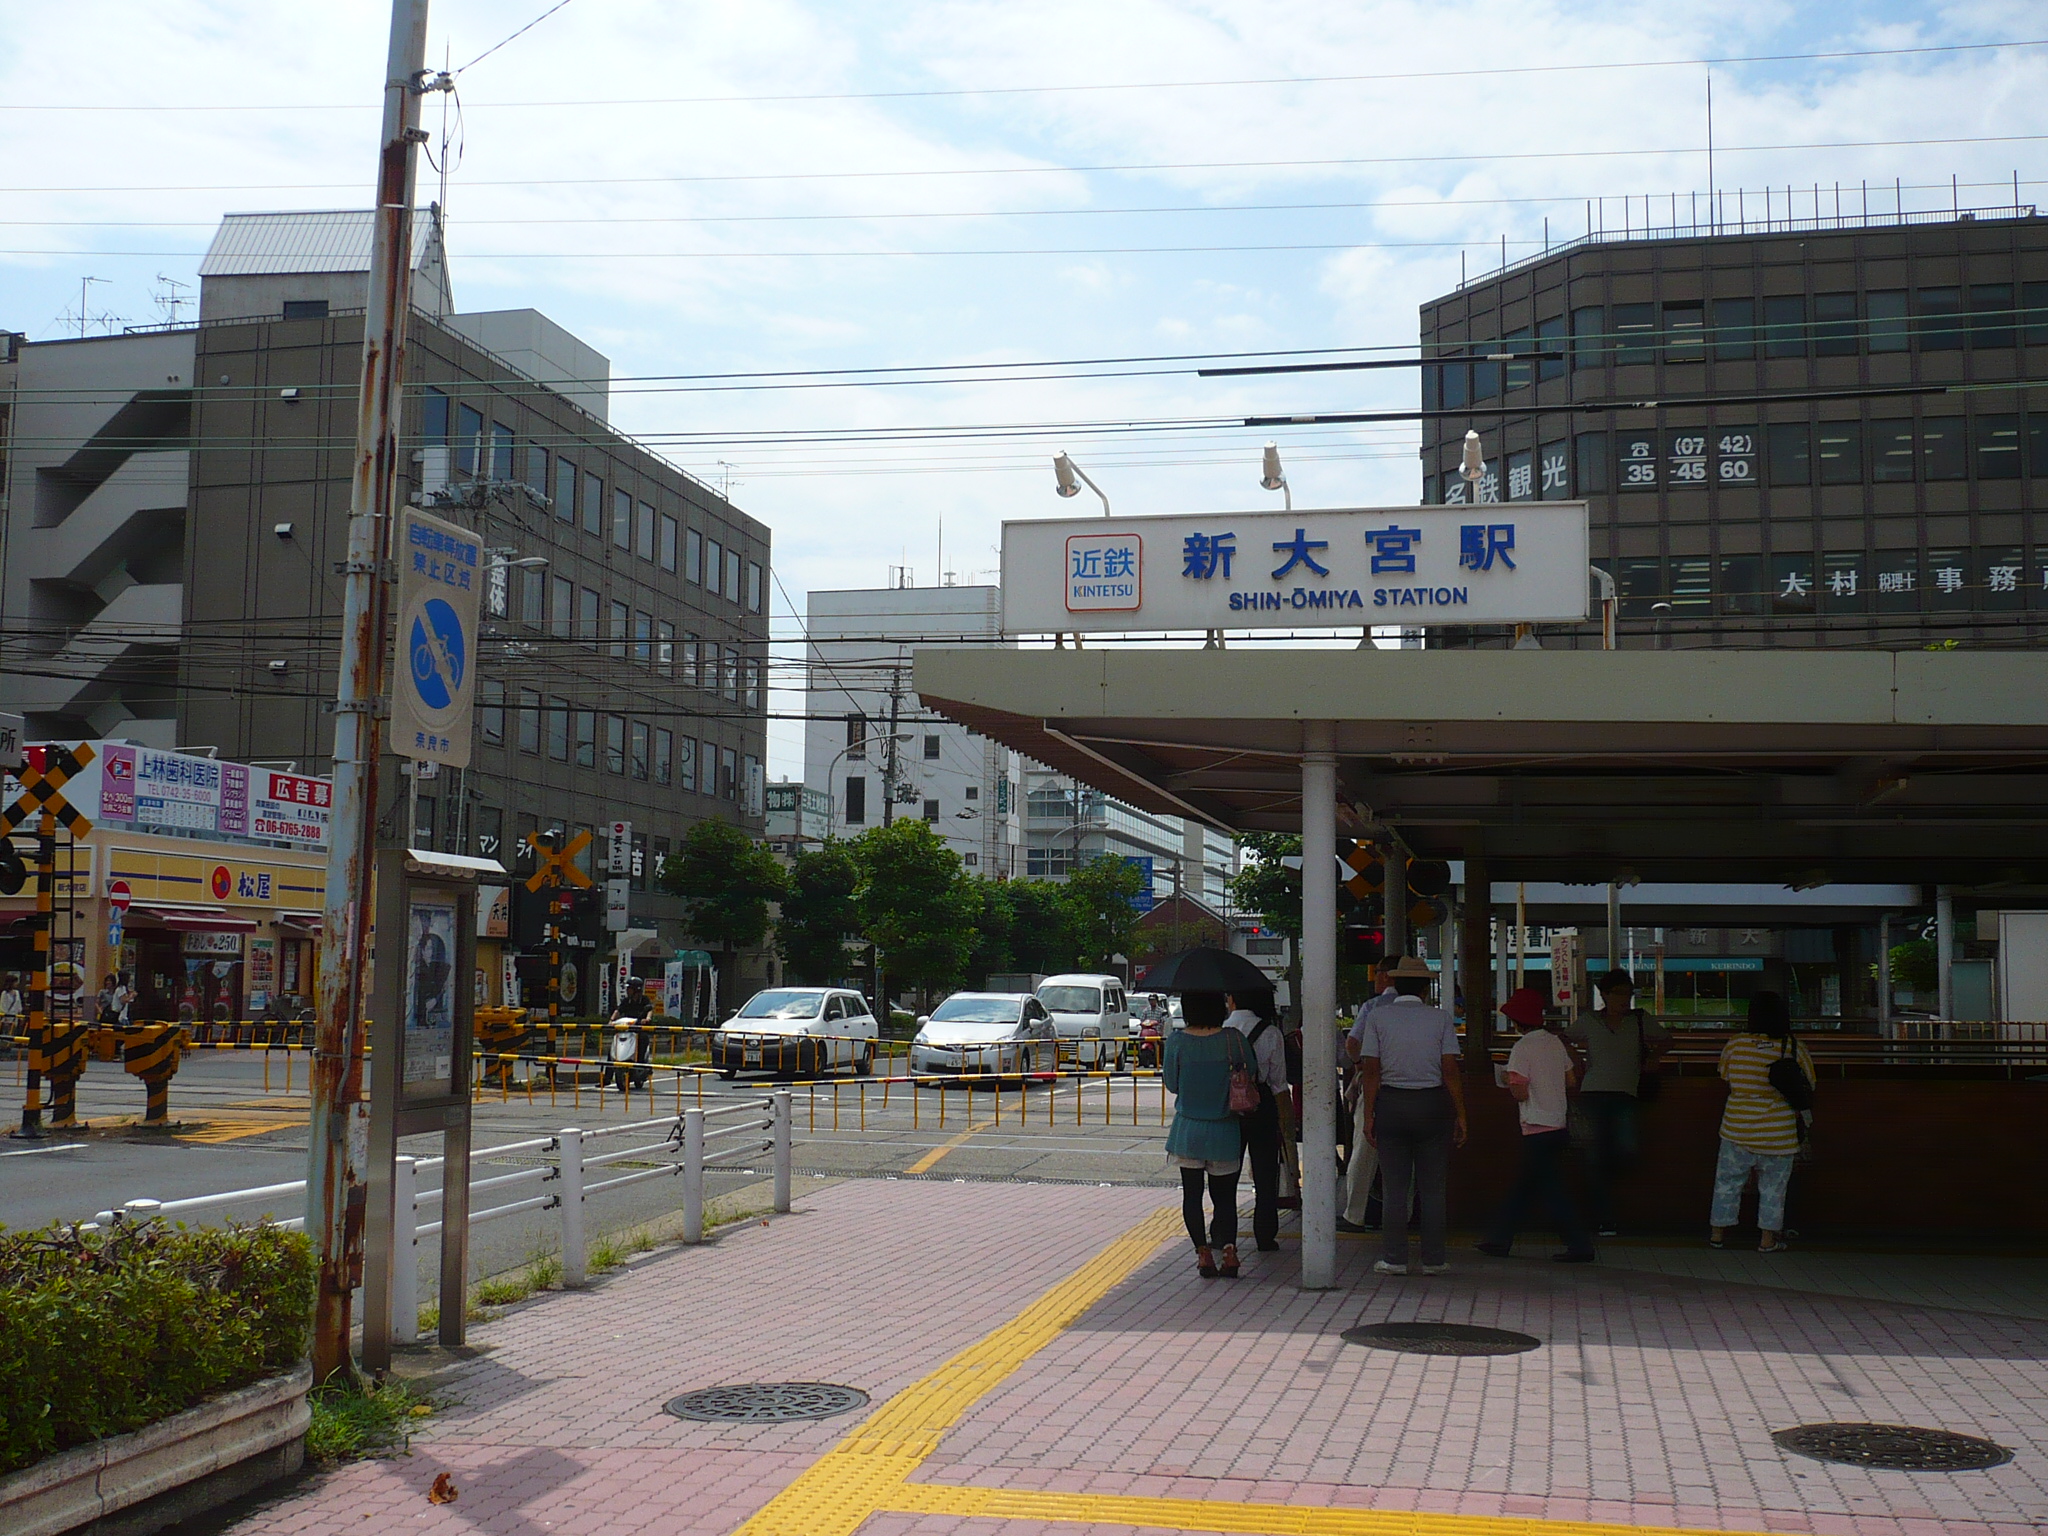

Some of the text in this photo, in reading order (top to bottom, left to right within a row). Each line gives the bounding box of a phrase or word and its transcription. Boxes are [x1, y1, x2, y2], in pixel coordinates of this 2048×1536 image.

[409, 522, 477, 567] 自転車等放置
[1181, 523, 1517, 581] 新大宮駅
[413, 551, 471, 591] 禁止区域
[1071, 547, 1135, 579] 近鉄
[1073, 583, 1134, 598] KINTETSU
[1373, 586, 1468, 607] STATION
[0, 727, 16, 753] 所
[415, 732, 449, 753] 奈良市
[138, 752, 219, 790] 上林歯科医院
[148, 784, 211, 803] TEL 0742-35-6000
[266, 820, 321, 839] 06-6765-2888
[238, 871, 271, 899] 松屋
[1711, 962, 1754, 970] KEIRINDO
